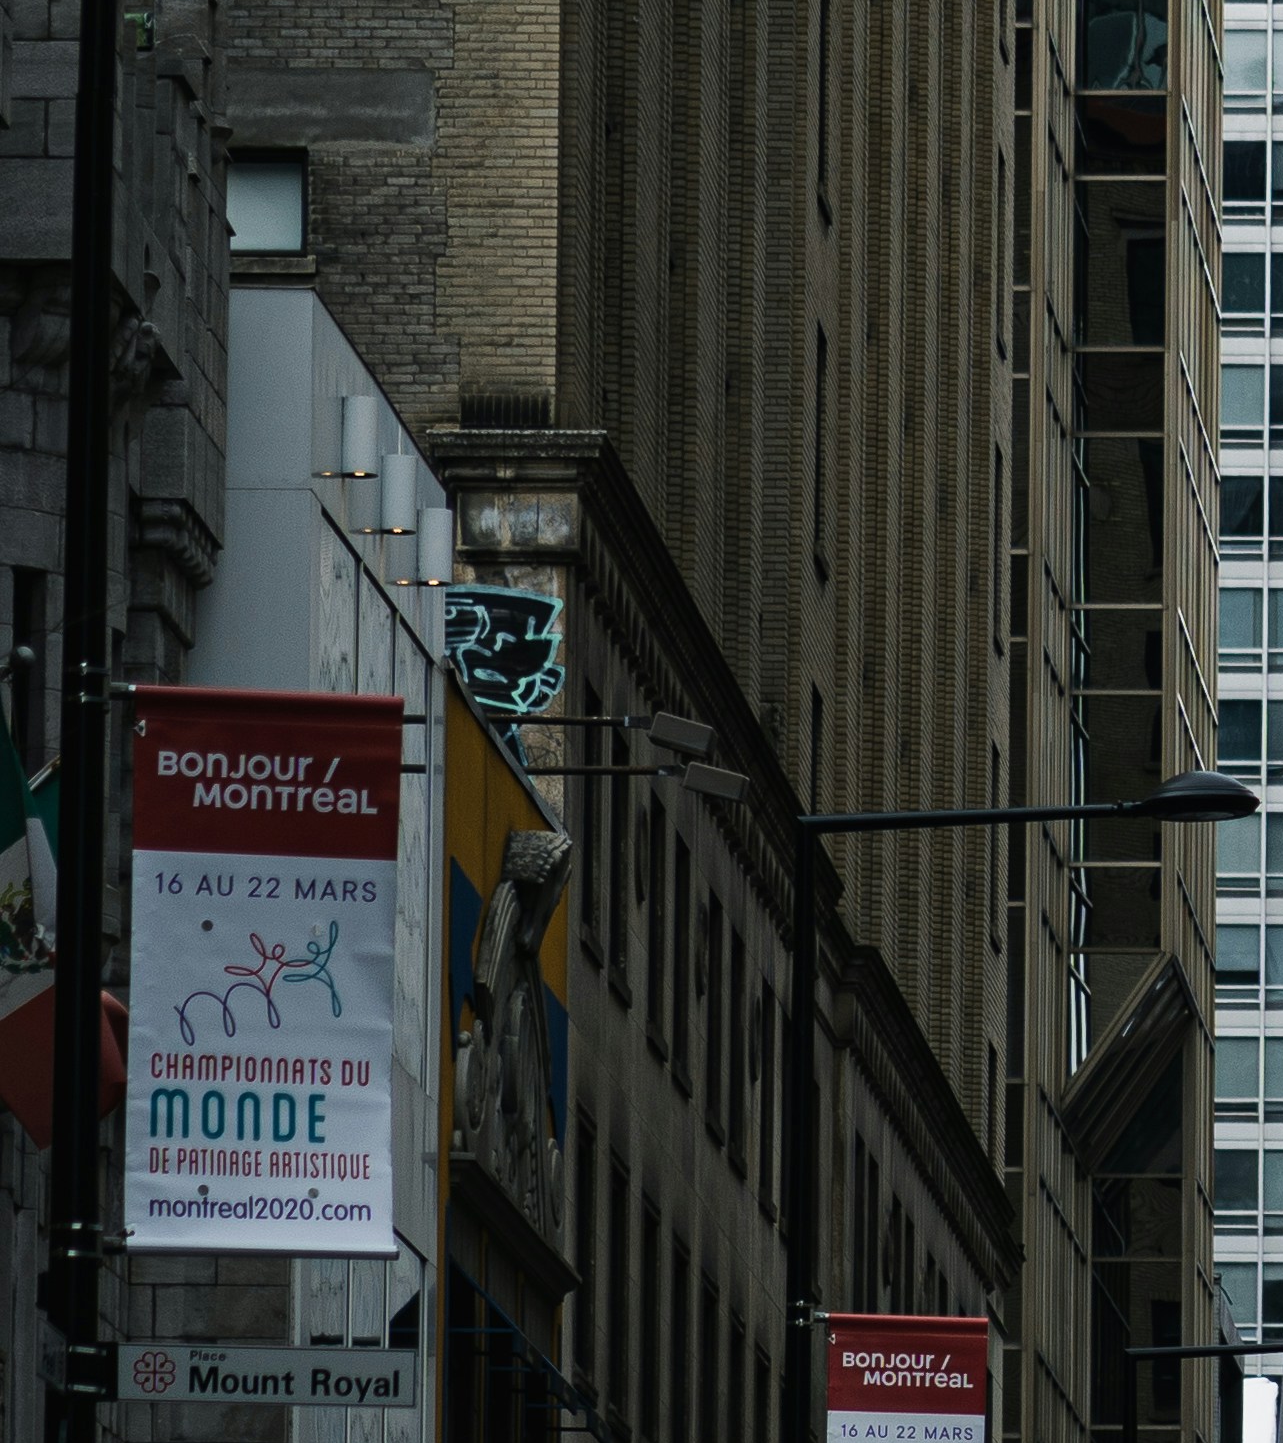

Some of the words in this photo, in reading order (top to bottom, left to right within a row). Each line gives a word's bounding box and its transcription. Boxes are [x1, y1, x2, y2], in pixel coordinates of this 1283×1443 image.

[155, 873, 183, 895] 16
[195, 875, 233, 897] AU
[248, 877, 280, 899] 22
[295, 879, 377, 902] MARS
[151, 1053, 332, 1086] CHAMPIONNATS
[341, 1060, 370, 1086] DU
[150, 1088, 326, 1144] MONDE
[150, 1147, 169, 1174] DE
[177, 1148, 262, 1177] PATINAGE
[270, 1152, 370, 1181] ARTISTIQUE
[150, 1196, 371, 1221] montreal2020.com
[189, 1350, 226, 1362] Place
[188, 1365, 294, 1396] Mount
[311, 1368, 400, 1402] Royal
[841, 1424, 858, 1437] 16
[865, 1425, 888, 1438] AU
[896, 1426, 916, 1439] 22
[924, 1427, 973, 1441] MARS
